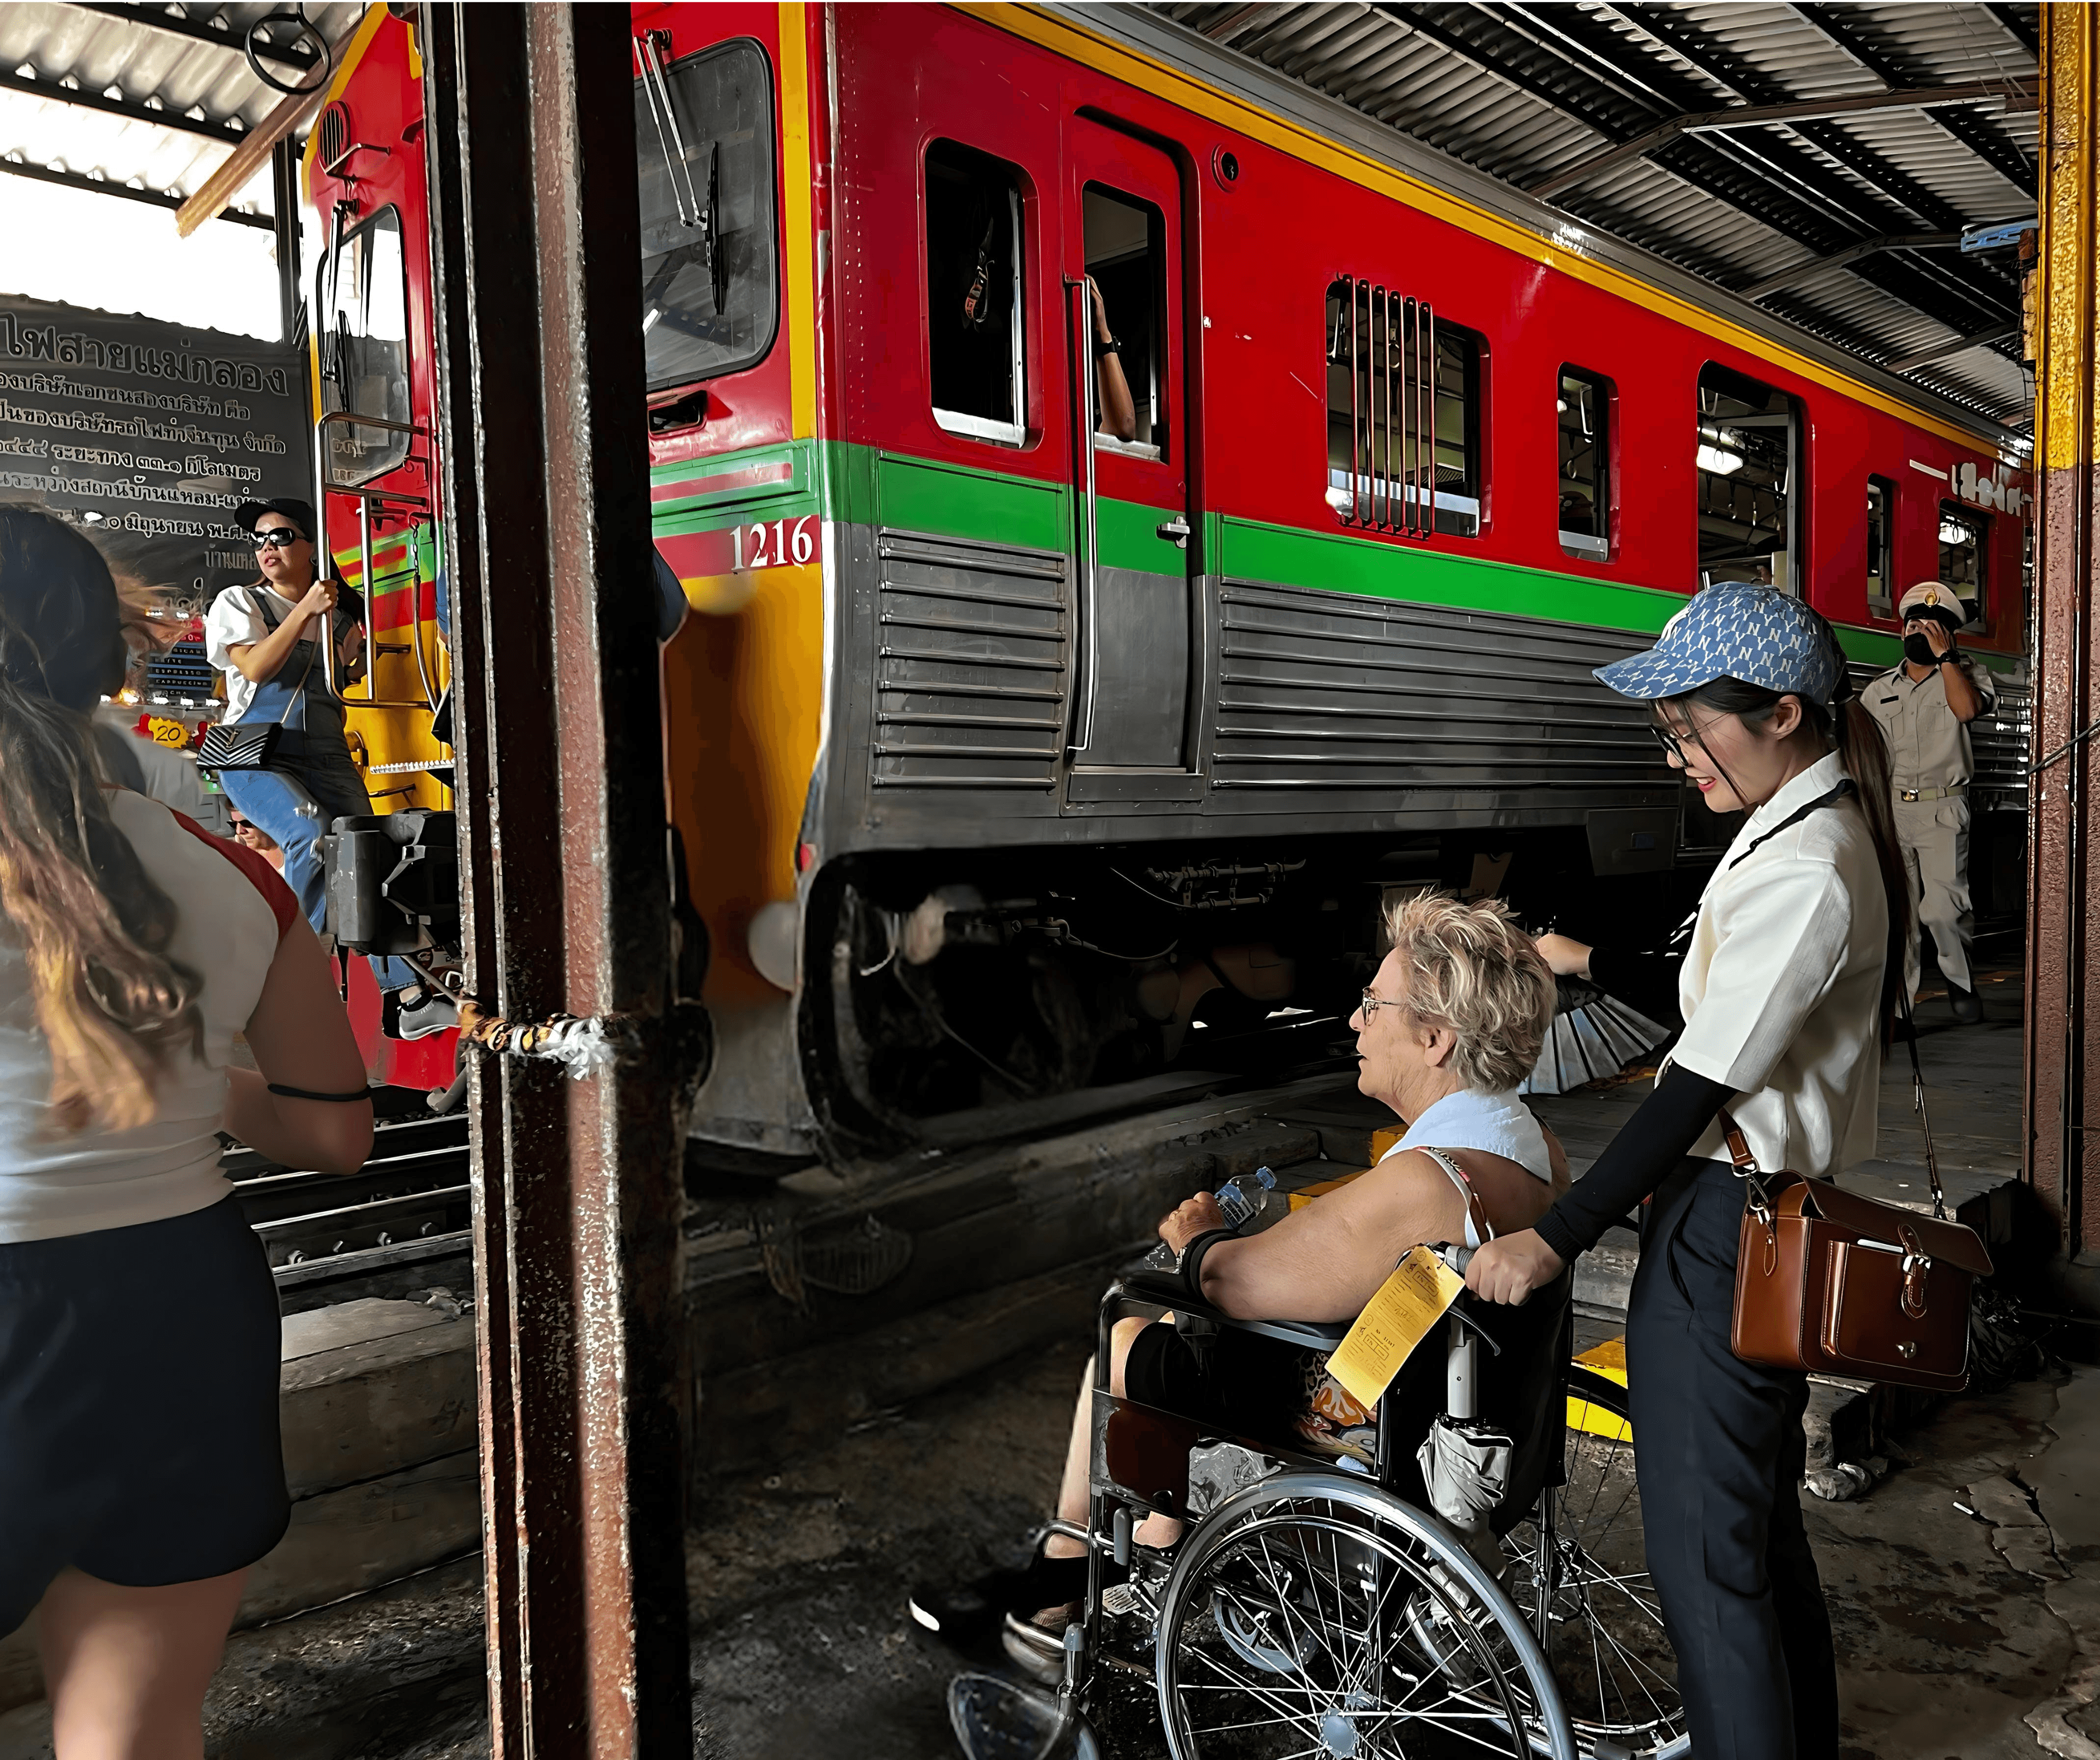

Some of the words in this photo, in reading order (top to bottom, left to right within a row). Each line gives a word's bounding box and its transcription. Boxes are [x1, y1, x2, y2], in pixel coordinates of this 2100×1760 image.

[51, 444, 133, 468] ระยะทาง
[185, 455, 261, 481] กิโลเมตร
[125, 511, 204, 538] มิถุนายน
[729, 515, 813, 571] 1216
[156, 725, 180, 742] 20
